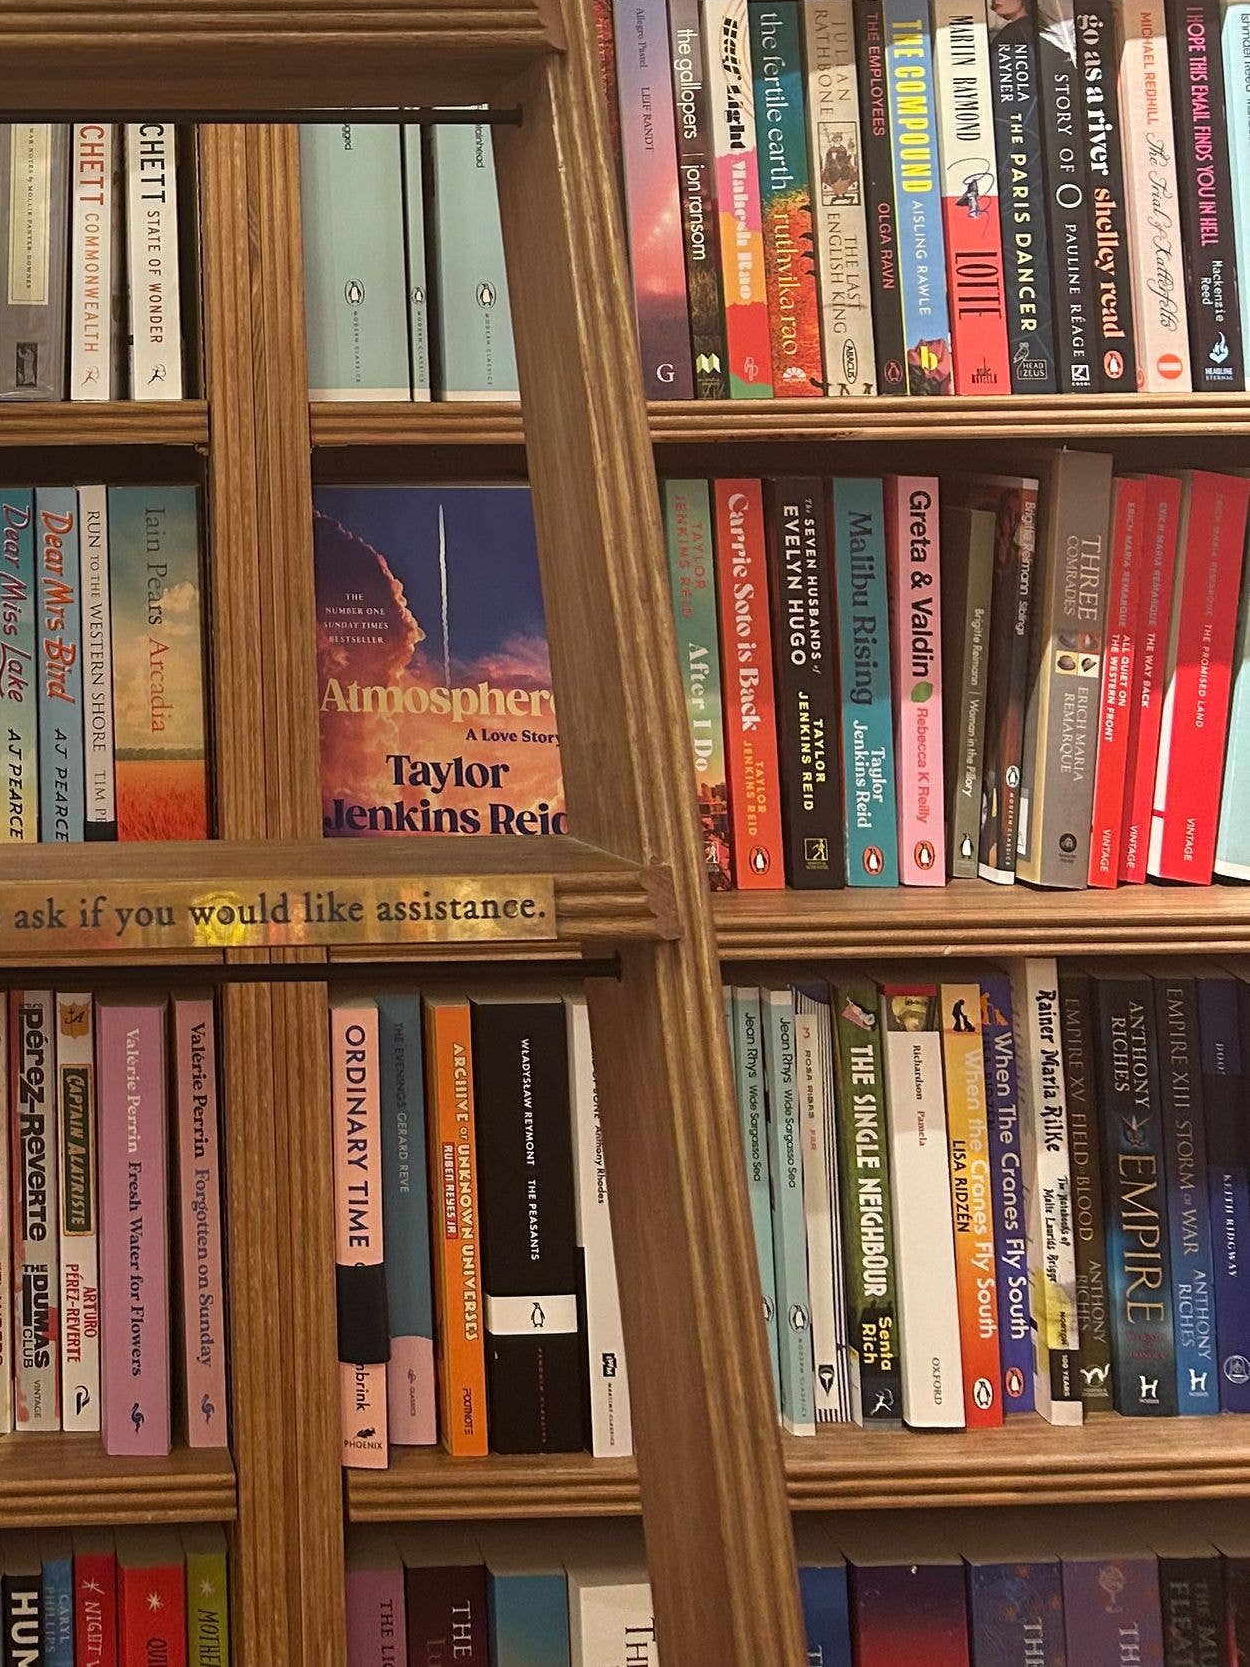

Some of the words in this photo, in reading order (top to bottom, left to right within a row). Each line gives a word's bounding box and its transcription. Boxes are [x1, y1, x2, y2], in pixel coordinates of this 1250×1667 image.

[677, 30, 697, 55] the
[675, 56, 701, 139] gallopers
[681, 165, 703, 192] jon
[1010, 155, 1031, 222] PARIS
[687, 198, 706, 261] ransom
[1065, 225, 1080, 295] PAULINE
[1093, 188, 1120, 276] shelley
[83, 213, 100, 353] COMMONWEALTH
[1014, 234, 1037, 333] DANCER
[1101, 283, 1125, 339] read
[1070, 304, 1086, 358] RÉAGE
[848, 511, 876, 607] Malibu
[909, 491, 932, 563] Greta
[910, 571, 933, 589] &
[849, 615, 879, 706] Rising
[910, 597, 934, 677] Valdin
[466, 730, 477, 740] A
[482, 729, 517, 742] Love
[386, 755, 509, 793] Taylor
[324, 799, 481, 834] Jenkins
[14, 899, 66, 929] ask
[80, 899, 105, 928] if
[116, 907, 177, 937] you
[190, 892, 291, 926] would
[304, 892, 365, 923] like
[376, 891, 546, 922] assistance.
[345, 1026, 368, 1171] ORDINARY
[850, 1046, 875, 1085] THE
[853, 1093, 879, 1169] SINGLE
[348, 1181, 369, 1247] TIME
[858, 1178, 888, 1297] NEIGHBOUR
[1119, 1153, 1163, 1324] EMPIRE
[860, 1324, 876, 1363] Rich
[879, 1317, 891, 1370] Senta
